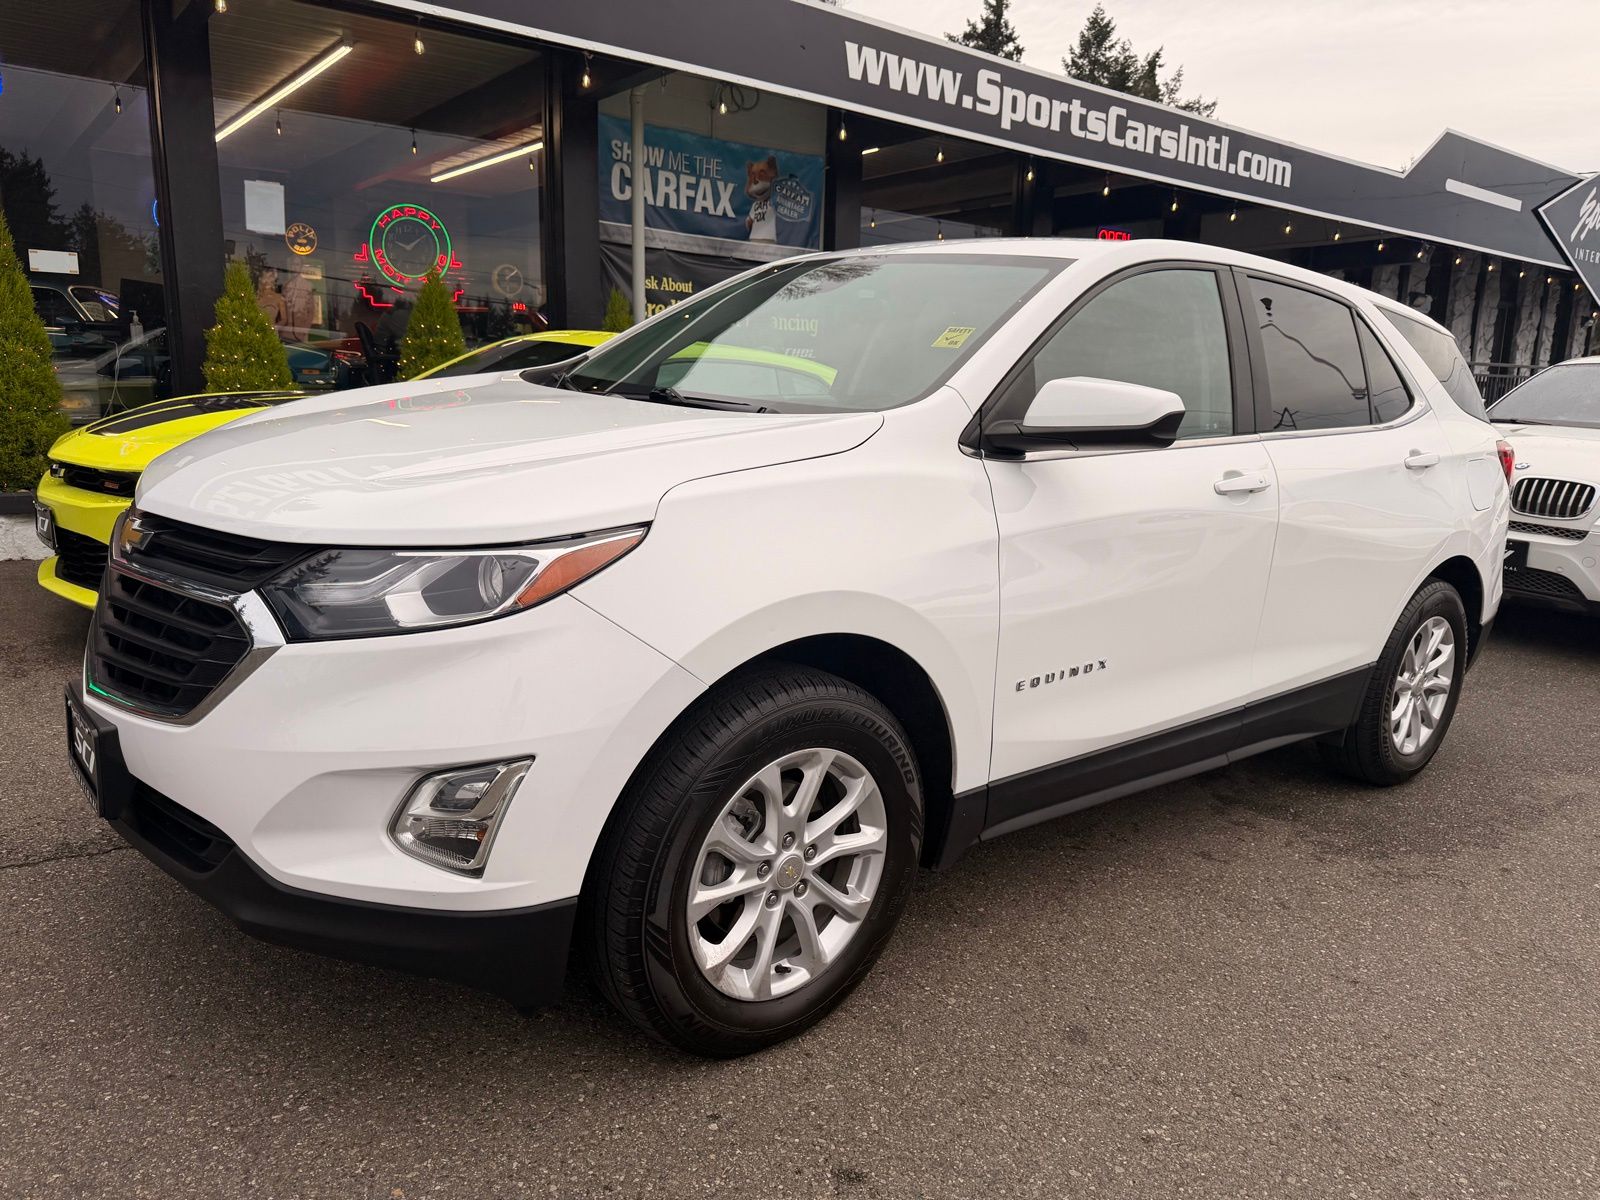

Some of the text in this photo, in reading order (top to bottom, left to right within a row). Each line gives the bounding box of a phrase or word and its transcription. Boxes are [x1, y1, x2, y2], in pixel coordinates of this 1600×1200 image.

[845, 41, 1292, 188] www.SportsCarsIntl.com
[611, 139, 723, 180] SHOW ME THE
[379, 207, 440, 228] HAPPY
[645, 275, 693, 294] sk About
[1015, 659, 1107, 692] EQUINOX
[851, 711, 916, 785] TOURING
